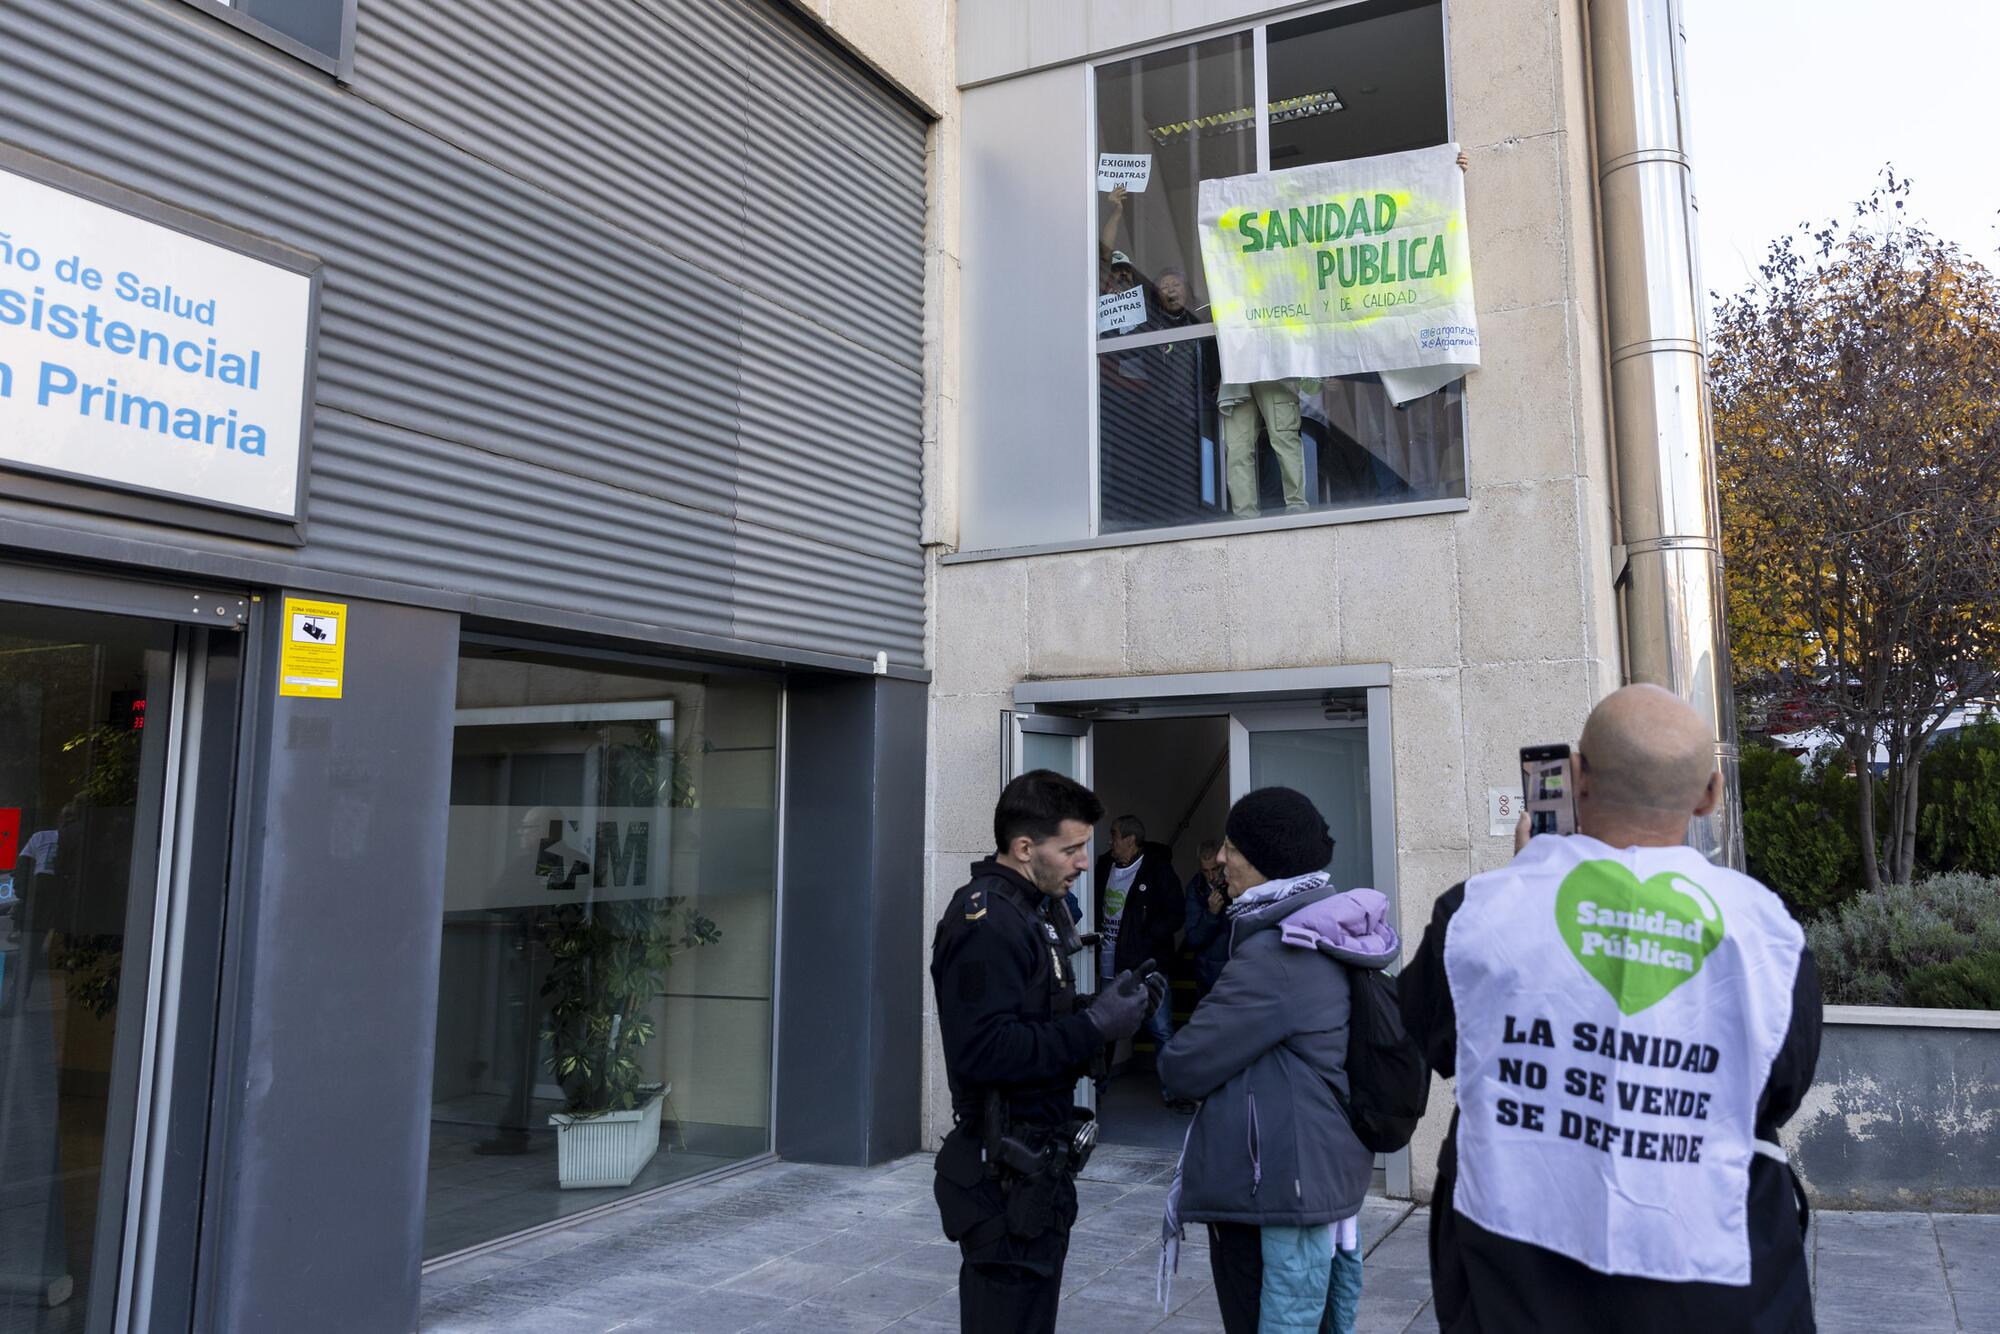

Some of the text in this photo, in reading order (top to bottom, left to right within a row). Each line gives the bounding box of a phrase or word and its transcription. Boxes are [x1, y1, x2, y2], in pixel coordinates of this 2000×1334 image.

[1098, 170, 1146, 179] PEDIATRAS
[1101, 159, 1146, 168] EXIGIMOS
[1238, 193, 1397, 253] SANIDAD
[1316, 234, 1448, 290] PUBLICA
[55, 255, 103, 291] de
[115, 271, 216, 327] Salud
[1100, 290, 1138, 307] XIGIMOS
[1100, 301, 1142, 318] EDIATRAS
[1245, 289, 1417, 321] UNIVERSAL Y DE CALIDAD
[37, 360, 266, 457] Primaria
[1576, 901, 1704, 944] Sanidad
[1580, 931, 1694, 972] Pública
[1502, 1015, 1720, 1074] LA SANIDAD
[1498, 1057, 1712, 1120] NO SE VENDE
[1496, 1098, 1704, 1164] SE DEFIENDE
